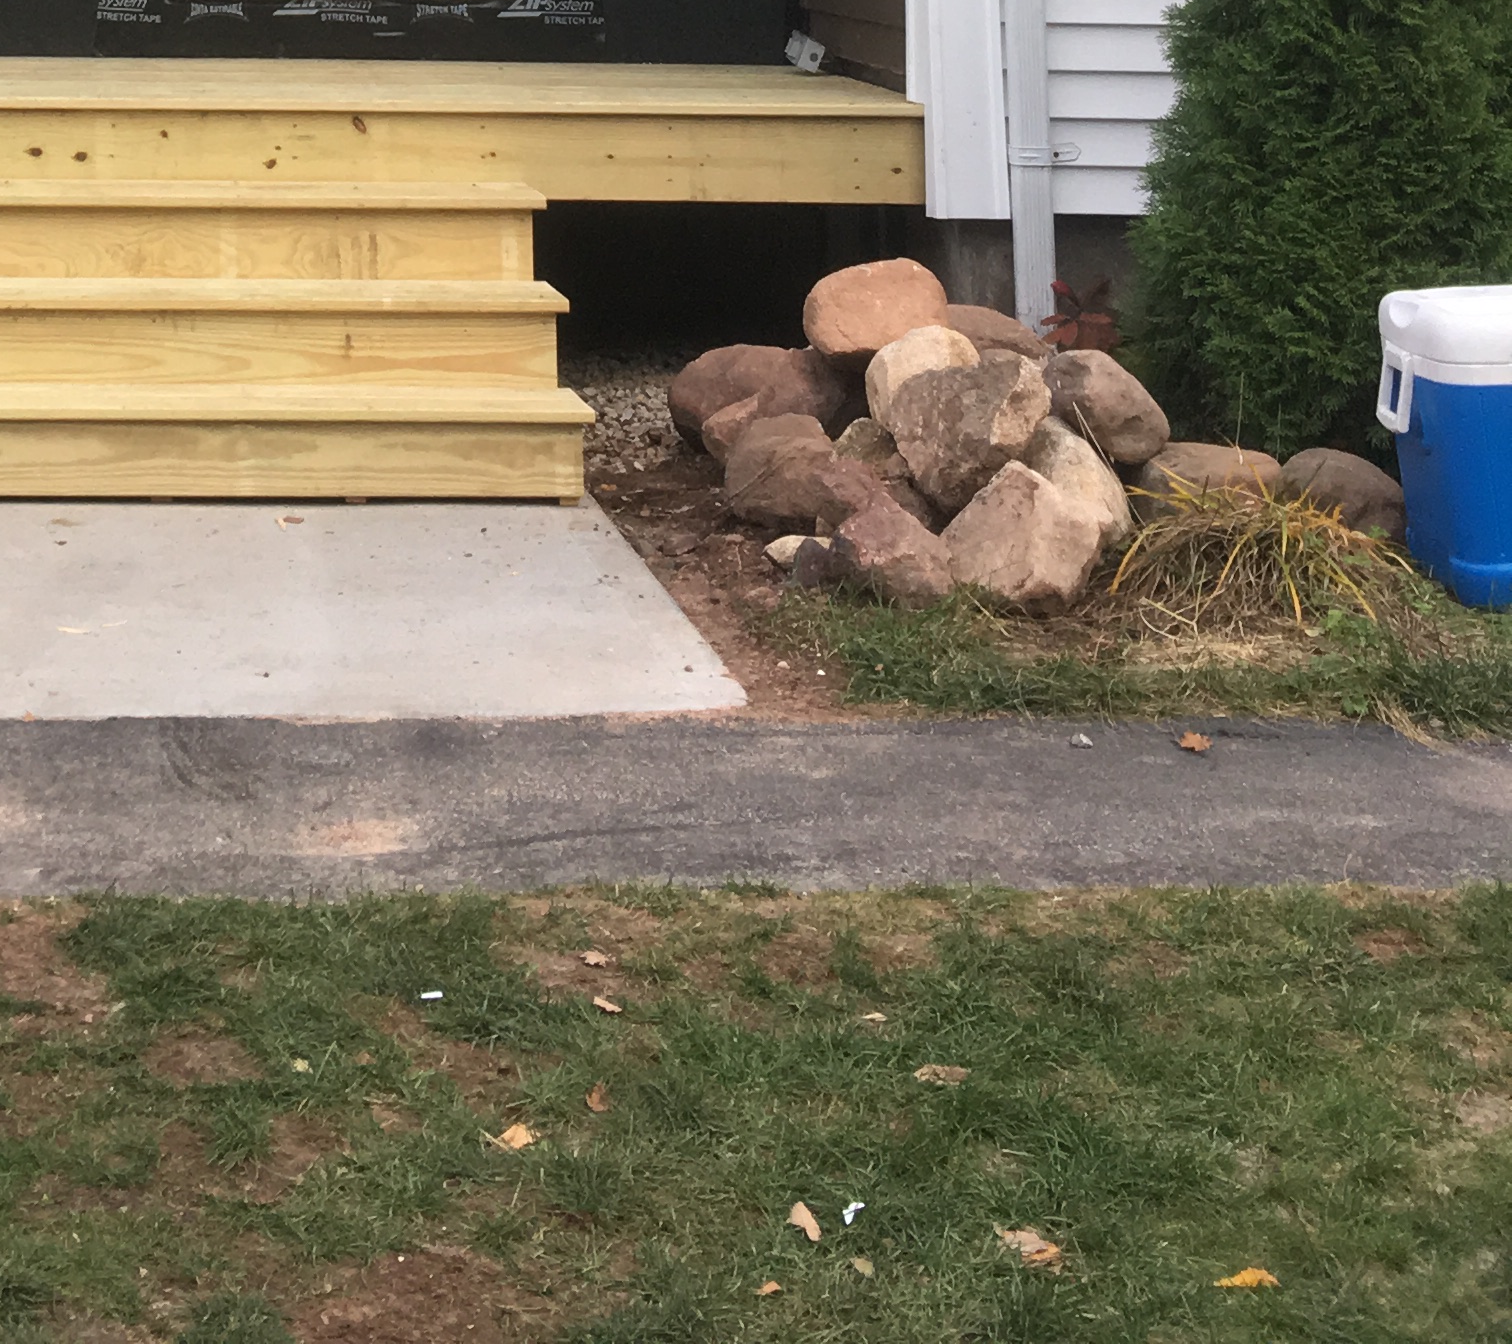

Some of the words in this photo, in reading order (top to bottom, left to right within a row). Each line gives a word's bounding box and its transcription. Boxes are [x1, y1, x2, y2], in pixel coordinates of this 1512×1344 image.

[97, 12, 138, 23] STRETCH
[138, 14, 162, 24] TAPE
[321, 13, 363, 23] STRETCH
[365, 15, 388, 24] TAPE
[544, 16, 585, 25] STRETCH
